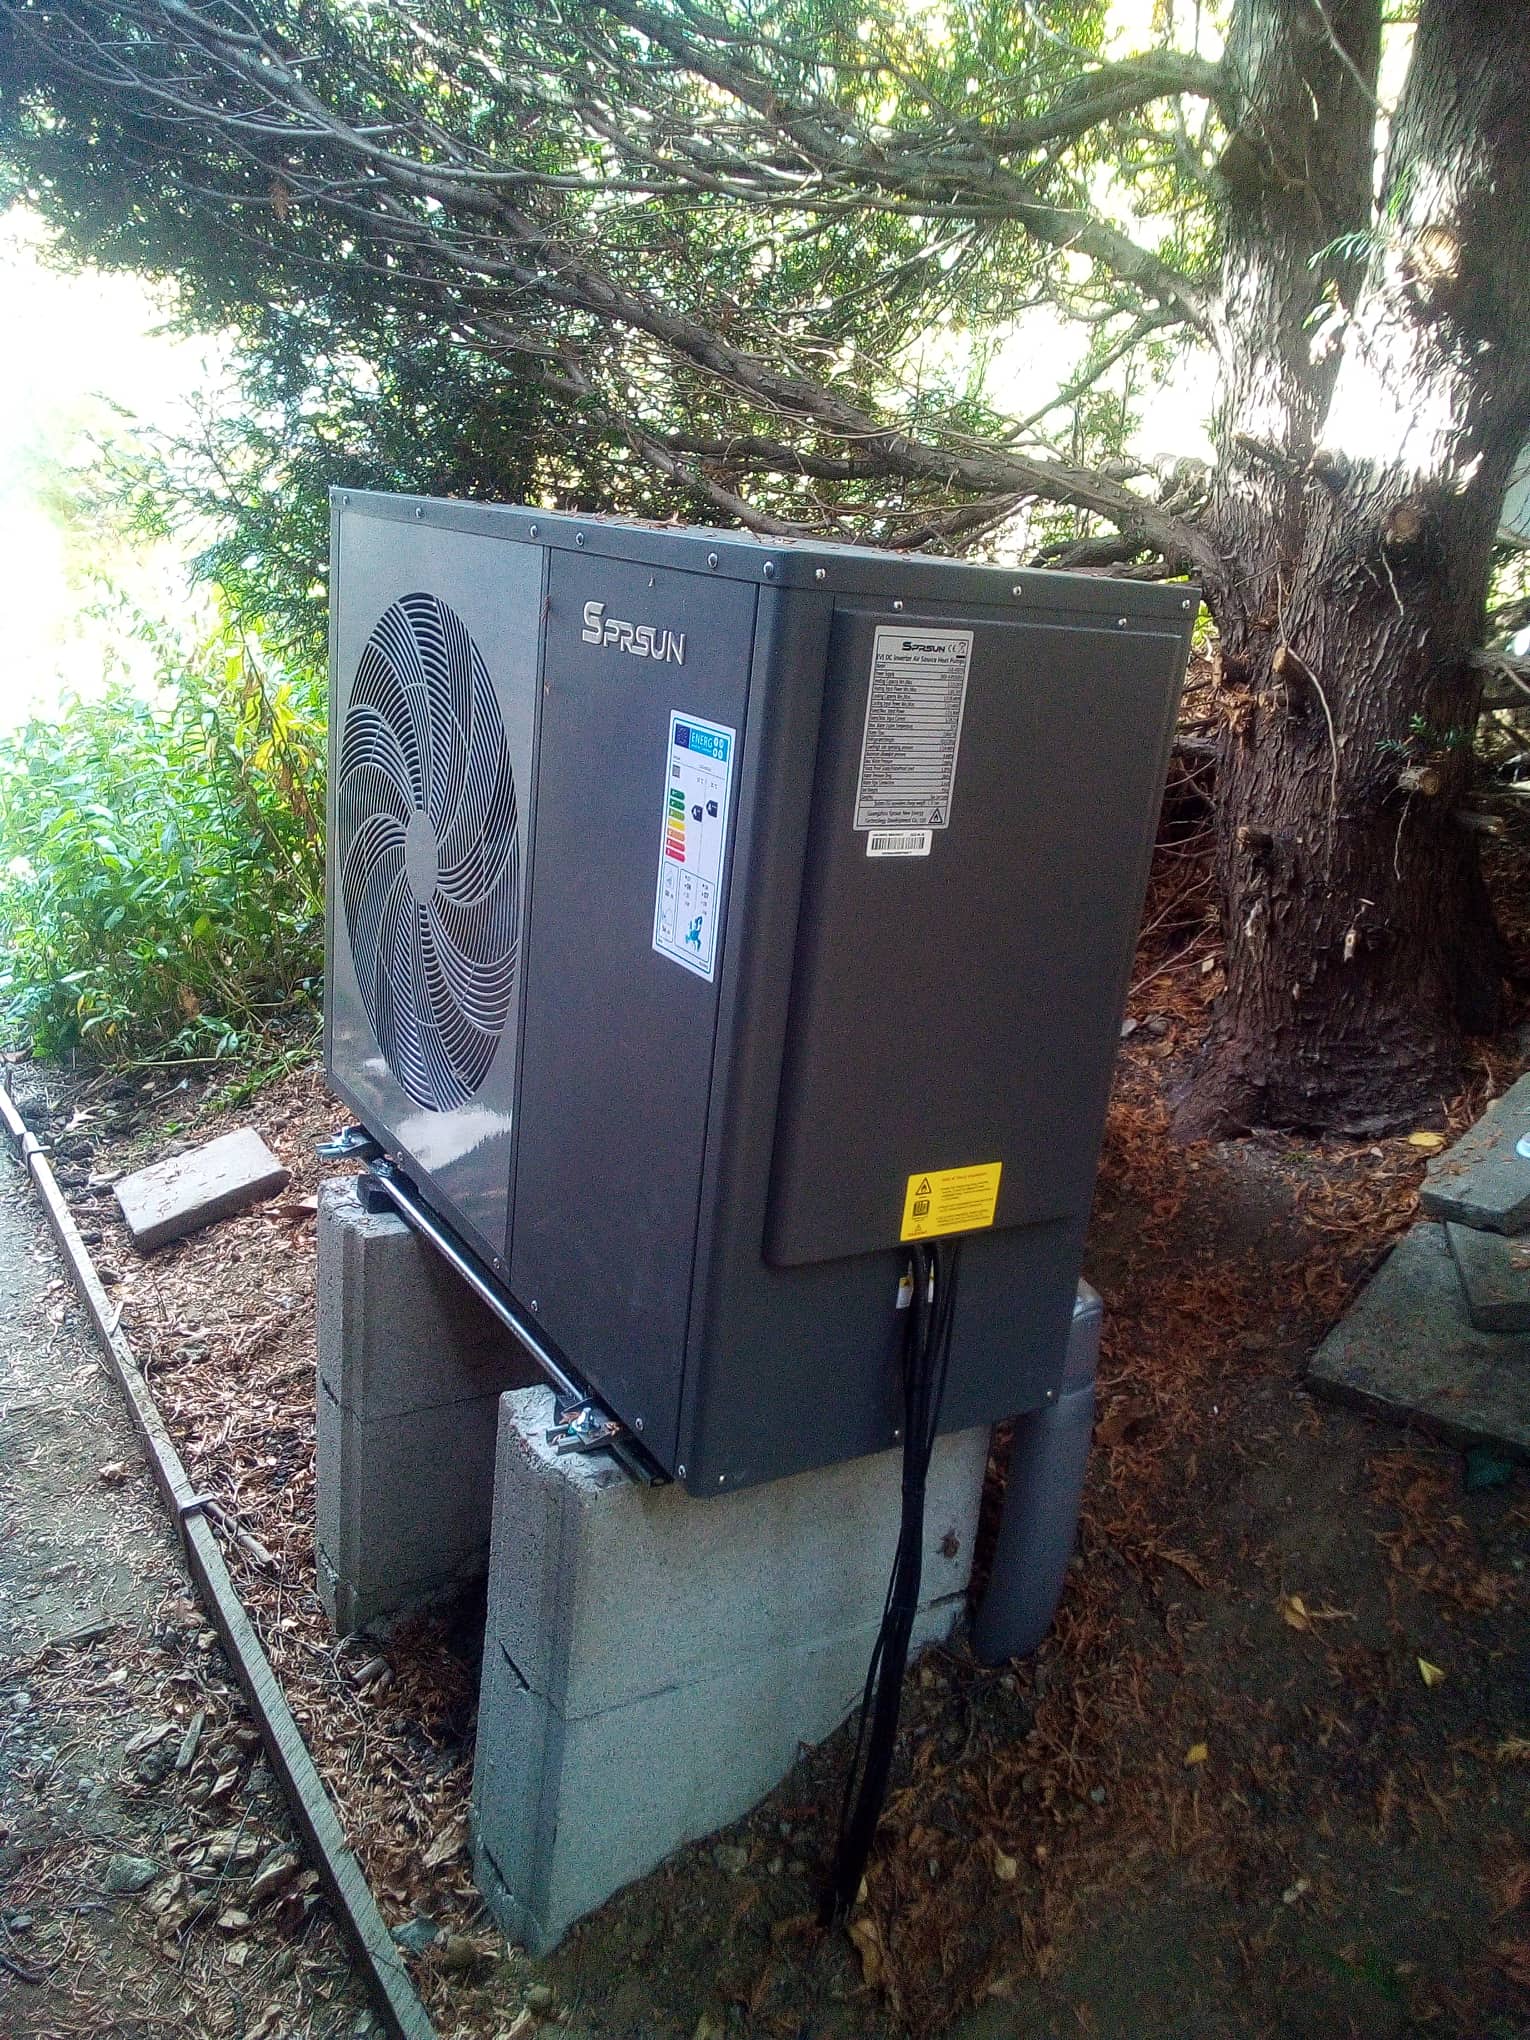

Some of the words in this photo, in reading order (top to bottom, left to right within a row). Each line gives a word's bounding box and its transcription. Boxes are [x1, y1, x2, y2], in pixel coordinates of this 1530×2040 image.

[582, 600, 686, 666] SPRSUN
[902, 641, 946, 653] SPRSUN
[691, 732, 713, 749] ENERG
